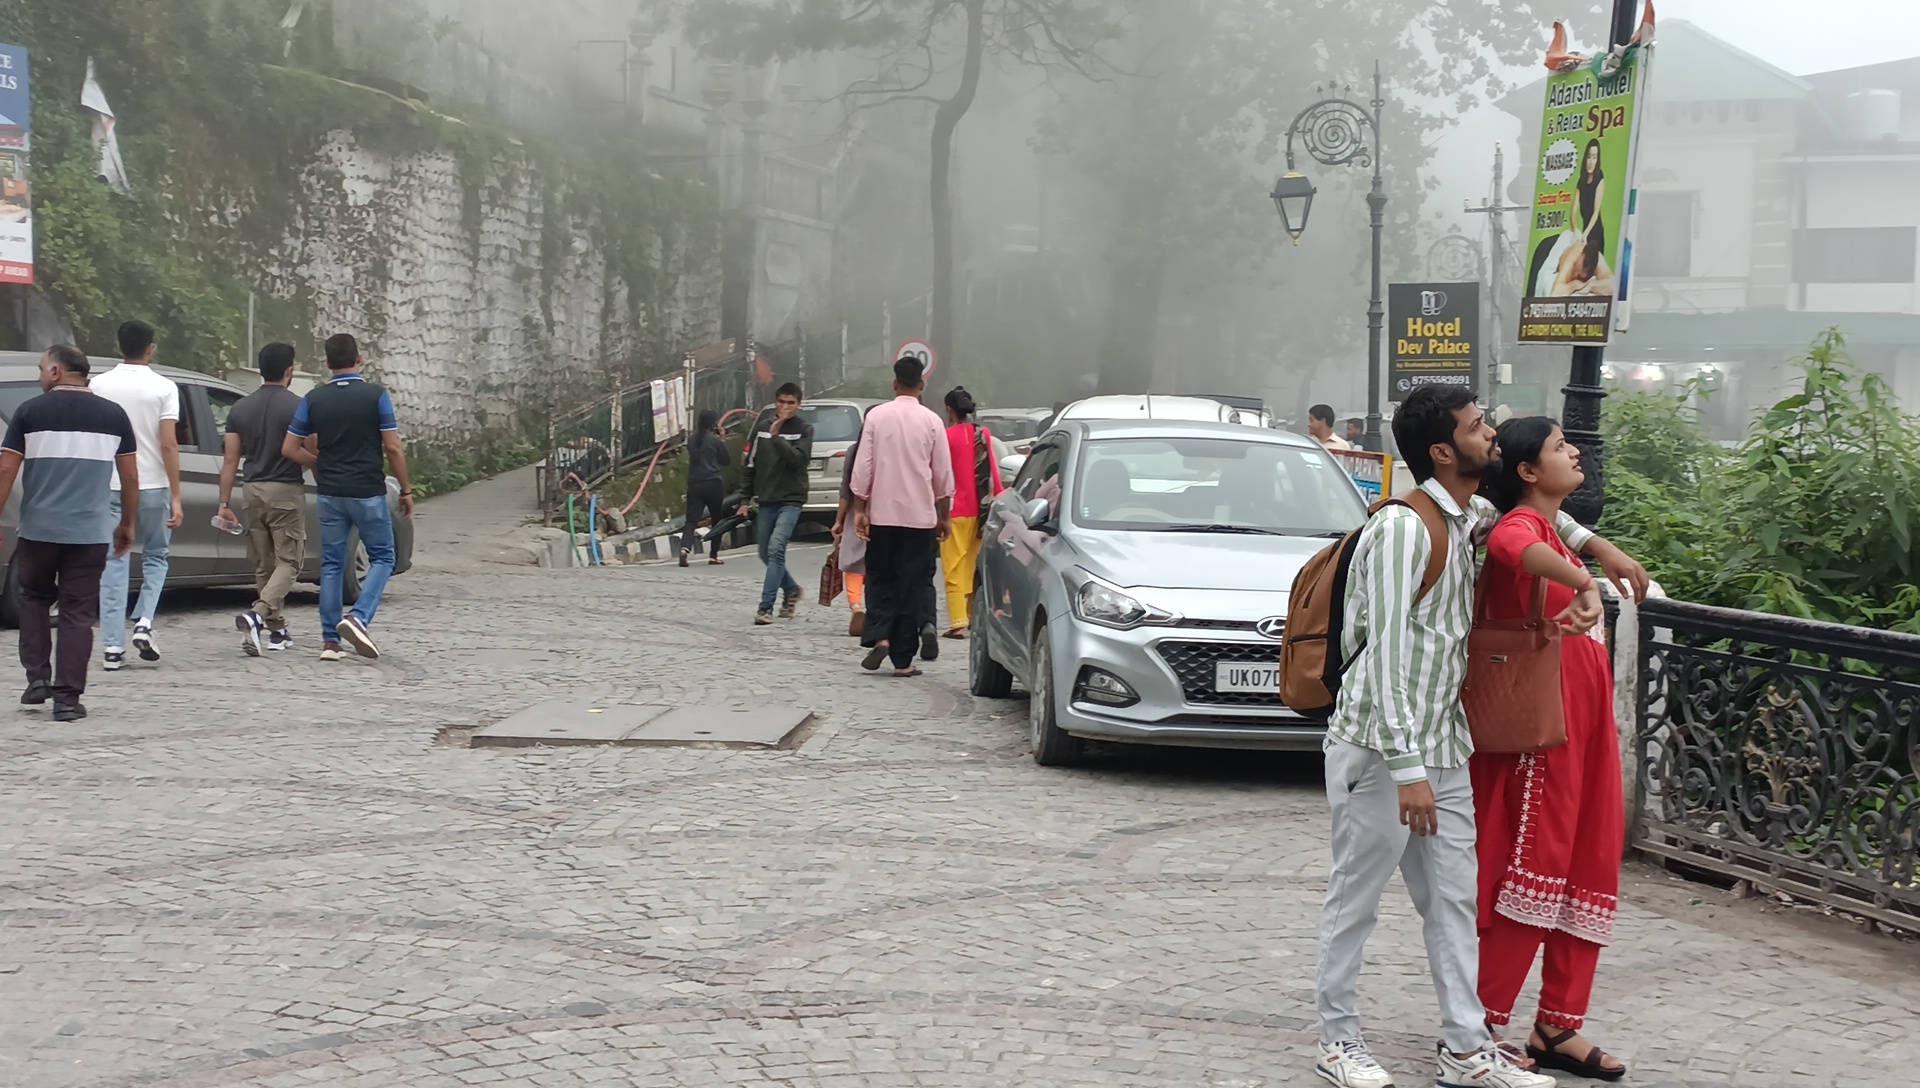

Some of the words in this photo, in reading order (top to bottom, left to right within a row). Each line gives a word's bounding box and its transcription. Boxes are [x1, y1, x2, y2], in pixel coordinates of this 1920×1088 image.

[1548, 78, 1592, 107] Adarsh
[1596, 68, 1632, 98] Hotel
[1547, 119, 1554, 136] &
[1555, 113, 1584, 133] Relax
[1585, 104, 1625, 138] Spa
[1544, 151, 1574, 171] MASSAGE
[1407, 317, 1461, 337] Hotel
[1397, 339, 1424, 355] Dev
[1428, 338, 1471, 355] Palace
